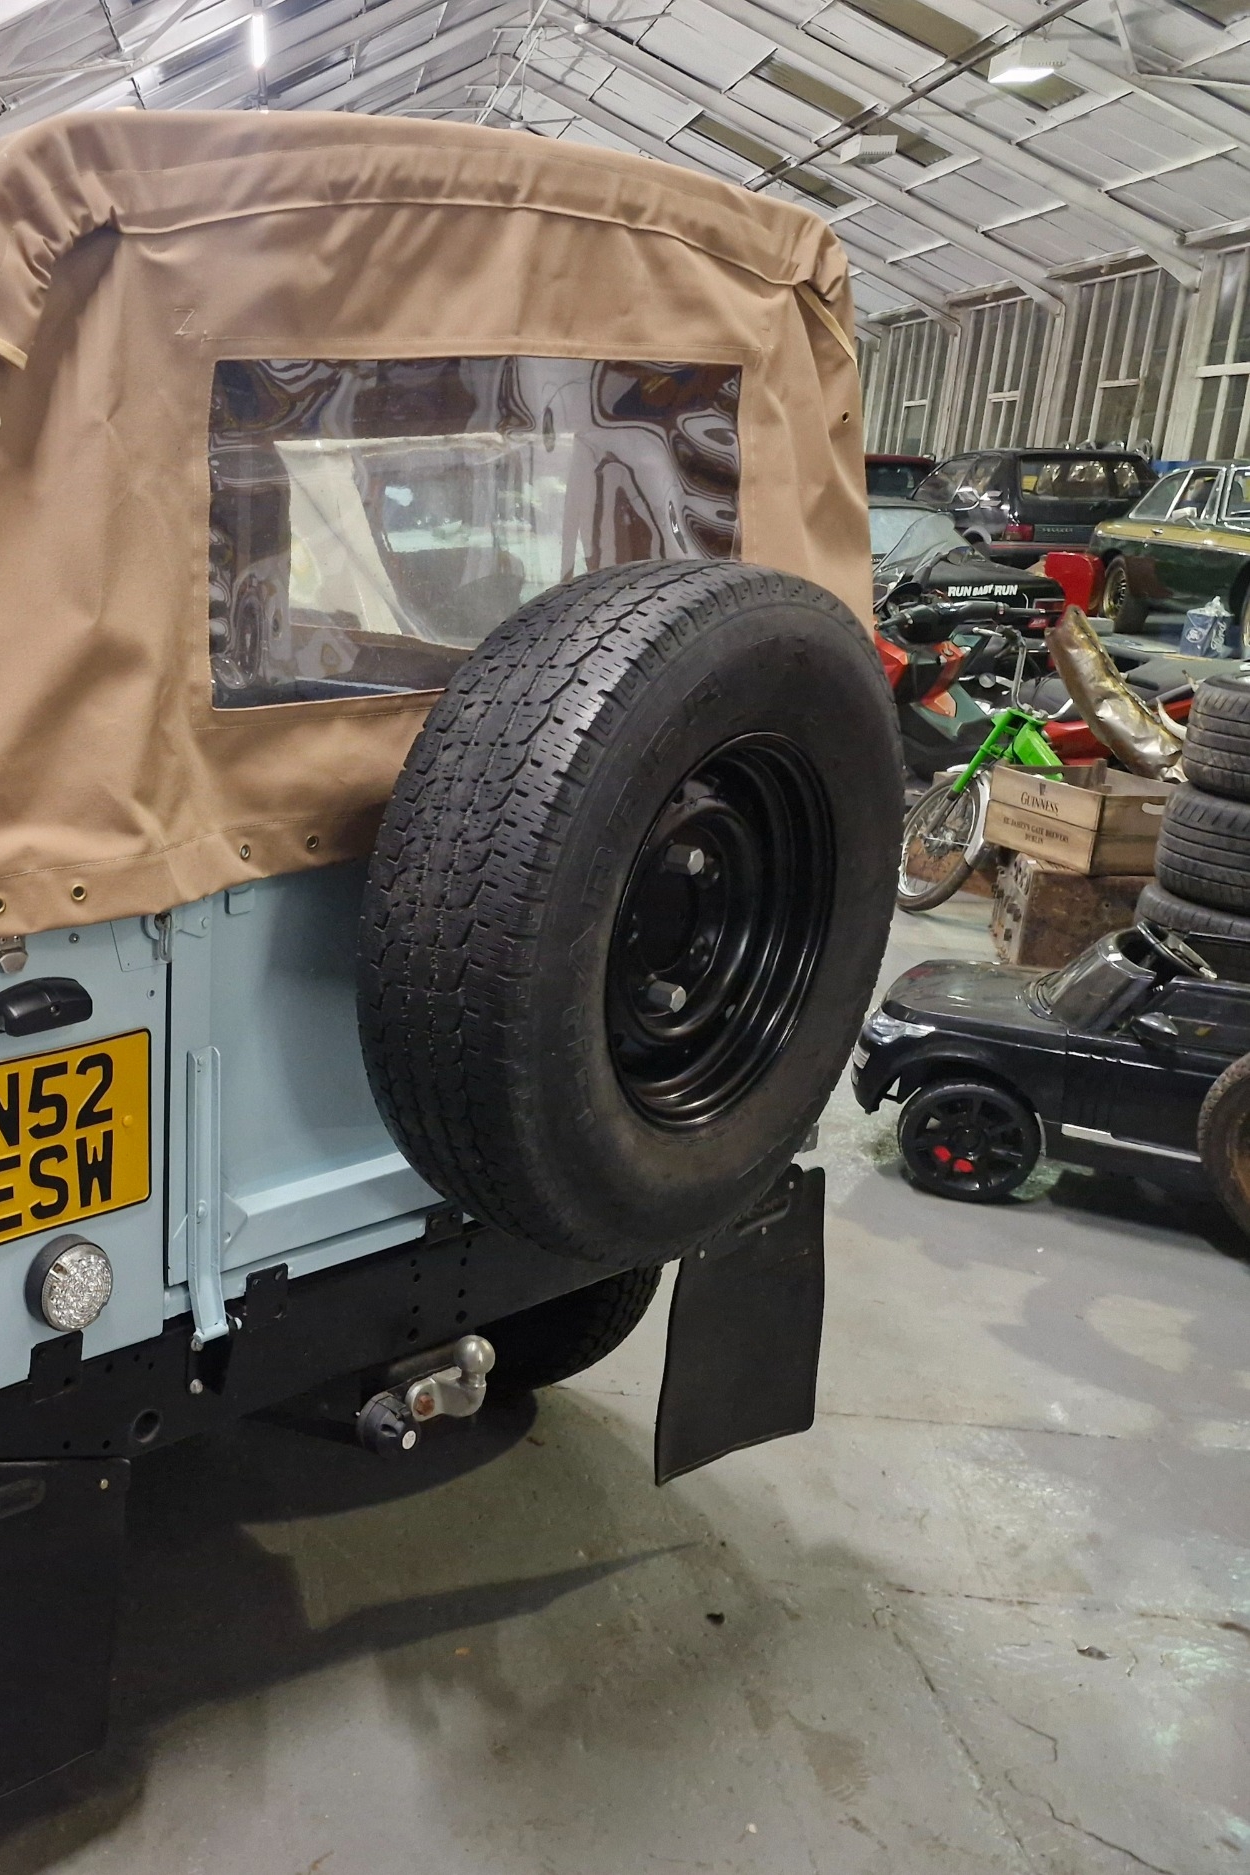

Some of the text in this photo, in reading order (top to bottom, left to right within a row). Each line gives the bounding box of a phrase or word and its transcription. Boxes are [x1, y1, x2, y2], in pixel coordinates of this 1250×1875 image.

[948, 584, 1018, 597] RUN BABY RUN
[1021, 791, 1059, 815] GUINNESS
[1031, 825, 1044, 836] GATE
[1045, 829, 1069, 843] BREWERY
